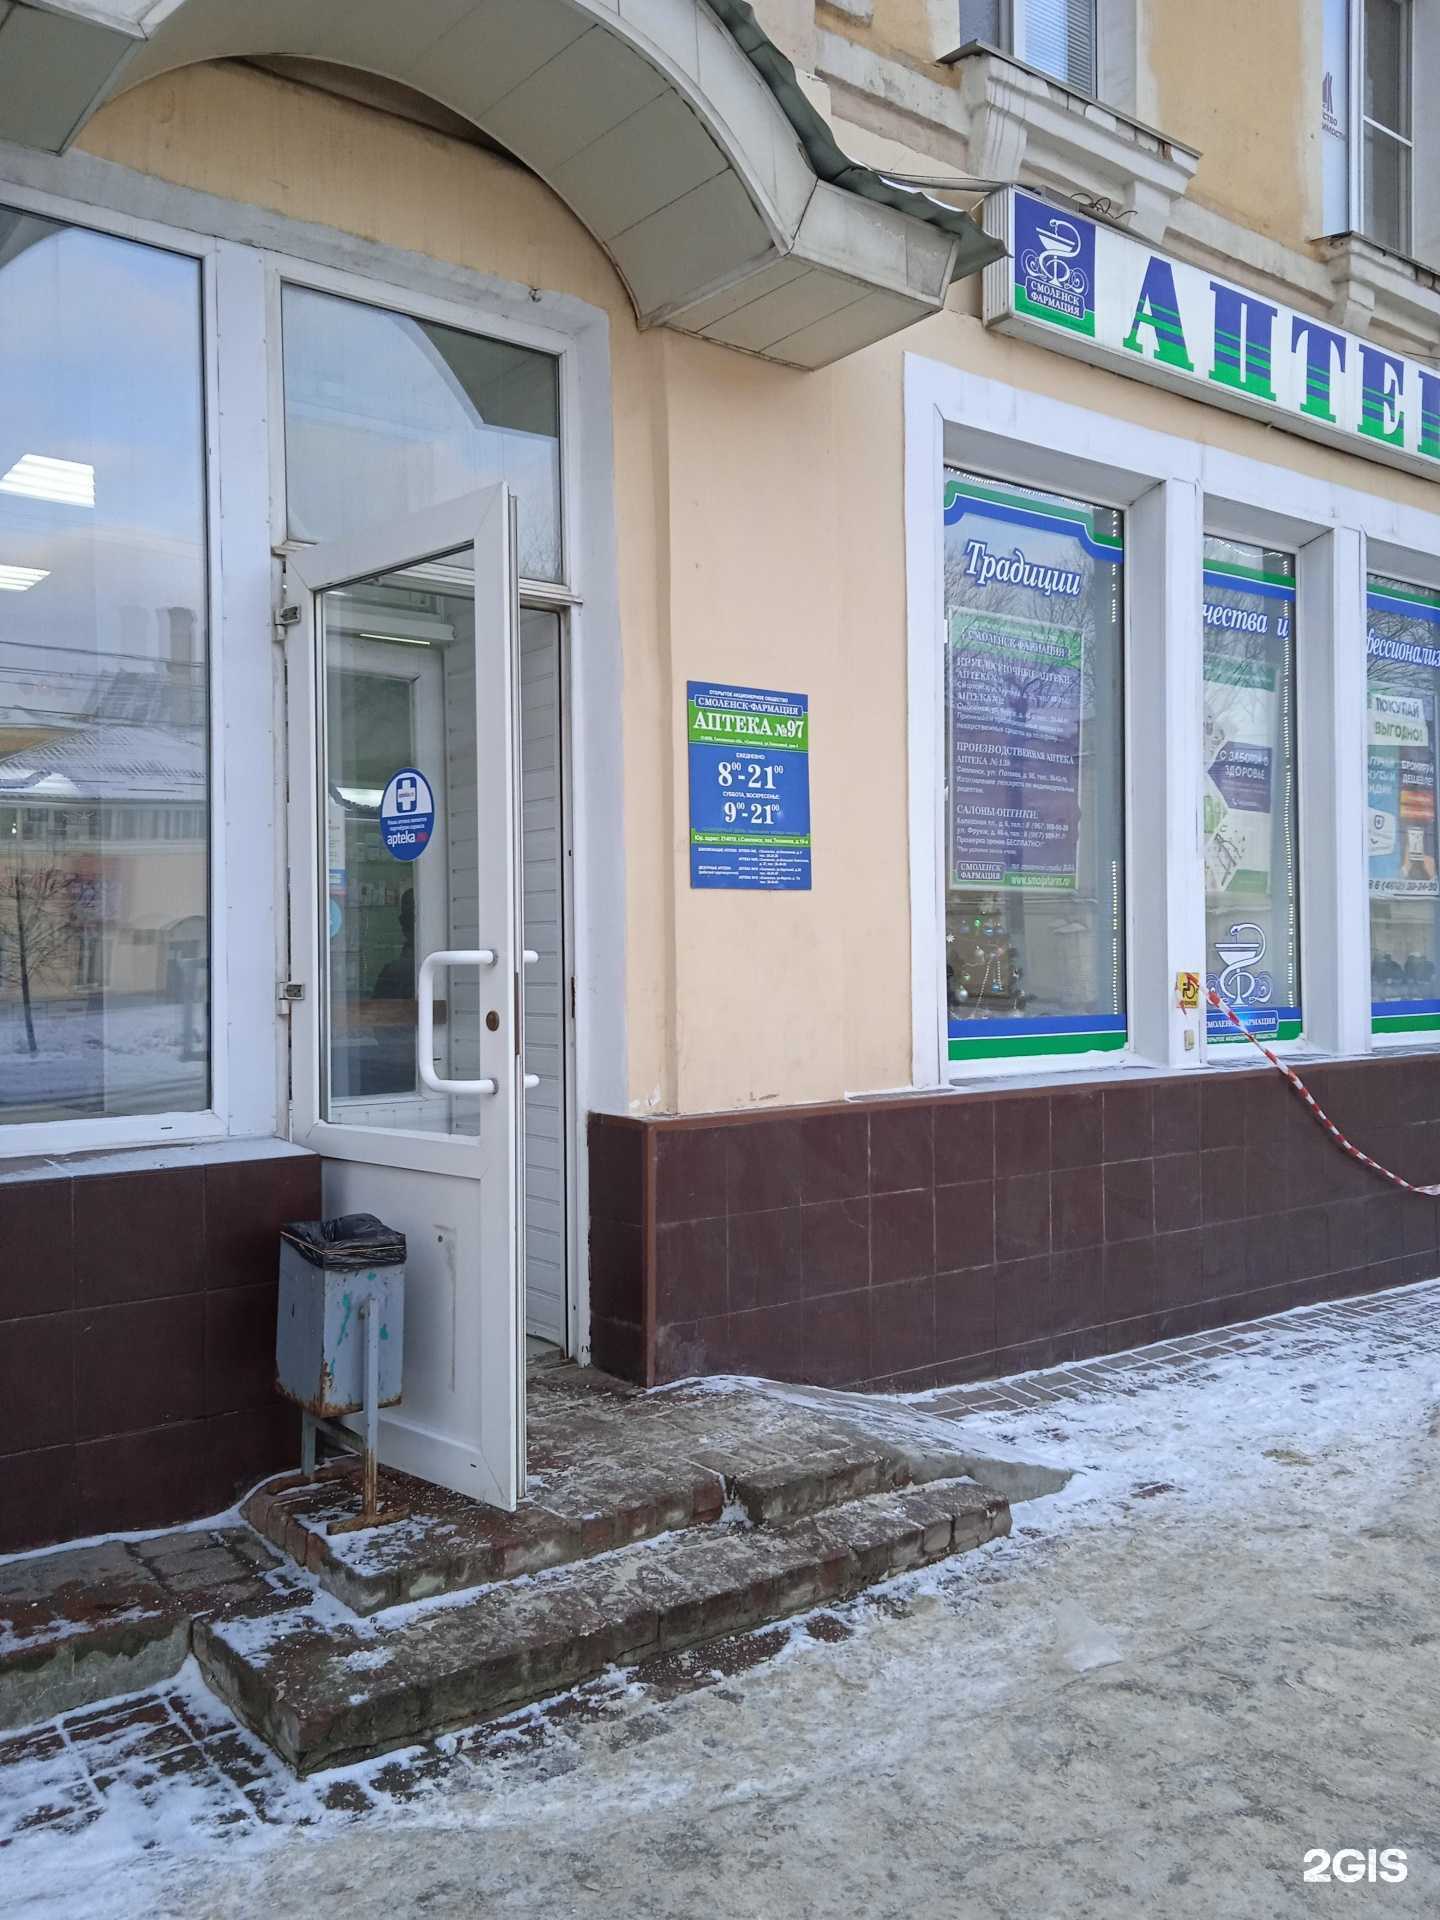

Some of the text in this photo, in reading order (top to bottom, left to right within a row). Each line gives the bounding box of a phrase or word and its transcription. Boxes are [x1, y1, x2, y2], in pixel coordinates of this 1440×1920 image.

[1030, 280, 1080, 306] СМОЛЕНСК
[1030, 292, 1080, 316] ФАРМАЦИЯ
[965, 540, 1081, 597] Традиции
[1276, 617, 1289, 638] и
[698, 697, 799, 715] СМОЛЕНСК-ФАРМАЦИЯ
[1375, 696, 1419, 718] ПОКУПАЙ
[693, 711, 804, 738] АПТЕКА №97
[956, 741, 1074, 765] ПРОИЗВОДСТВЕННАЯ АПТЕКА
[957, 755, 988, 765] АПТЕКА
[956, 804, 995, 817] САЛОНЫ
[960, 863, 1002, 872] СМОЛЕНСК
[960, 871, 1001, 880] ФАРМАЦИЯ
